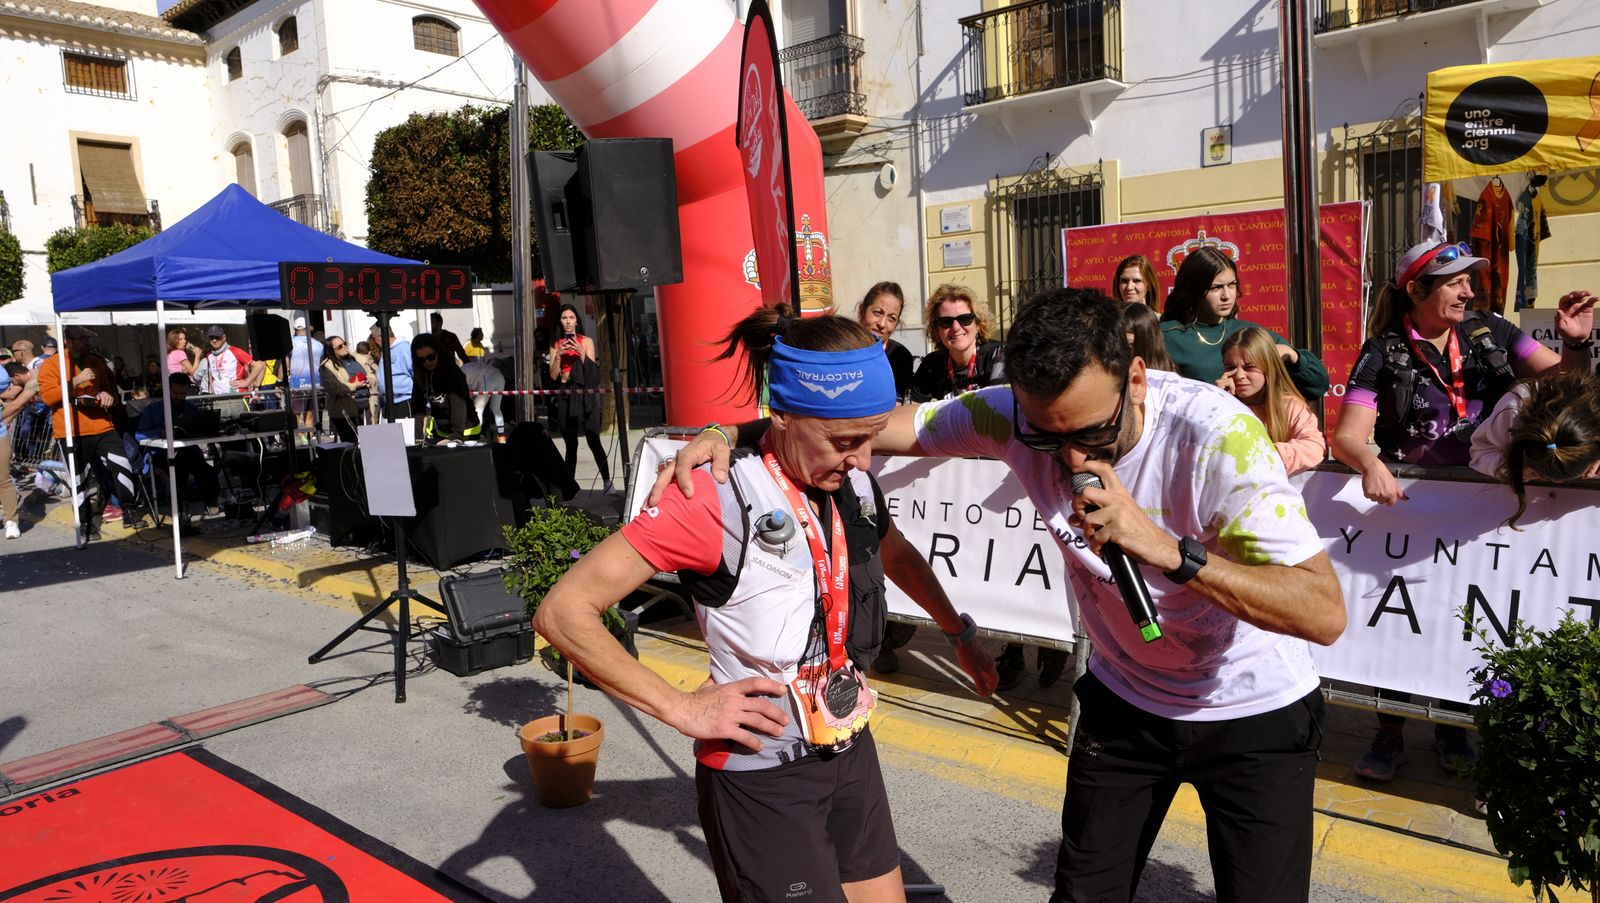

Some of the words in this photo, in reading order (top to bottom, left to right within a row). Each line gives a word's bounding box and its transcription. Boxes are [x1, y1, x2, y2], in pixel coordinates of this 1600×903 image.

[1464, 109, 1491, 119] uno
[1464, 118, 1504, 129] entre
[1464, 123, 1516, 138] cienmil
[1461, 138, 1489, 151] .org
[1239, 220, 1286, 232] CANTORIA
[1148, 228, 1191, 239] CANTORIA
[1067, 236, 1105, 247] CANTORIA
[1239, 262, 1287, 273] CANTORIA
[1068, 274, 1106, 285] CANTORIA
[290, 266, 466, 305] 03:03:02
[1239, 303, 1286, 313] CANTORIA
[751, 556, 793, 580] SALOMON
